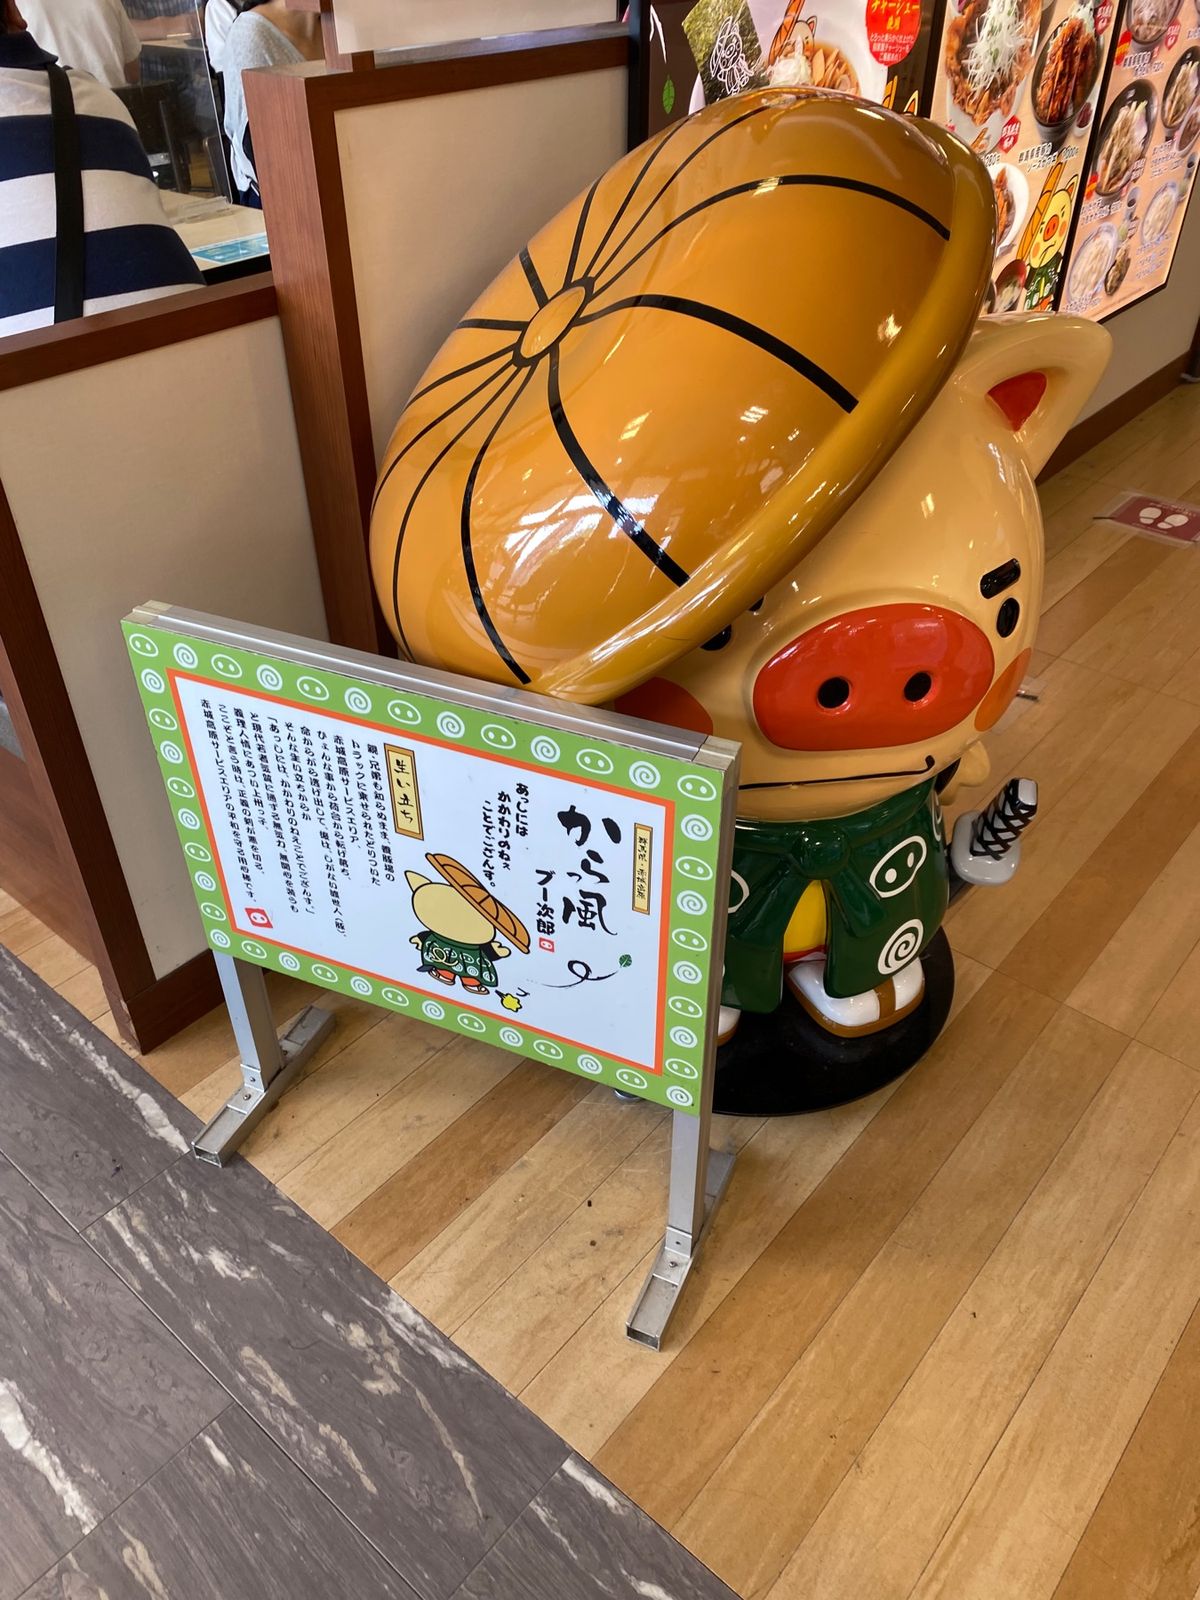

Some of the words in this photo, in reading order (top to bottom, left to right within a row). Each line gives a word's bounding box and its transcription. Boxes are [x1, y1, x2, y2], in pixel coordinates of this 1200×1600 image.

[284, 721, 311, 821] そんな生い立ちからか
[396, 760, 413, 823] 生い立ち
[515, 782, 529, 836] あっしには
[482, 800, 498, 887] ことでござんす。
[557, 804, 621, 935] からっ風
[535, 869, 555, 935] ブー次郎
